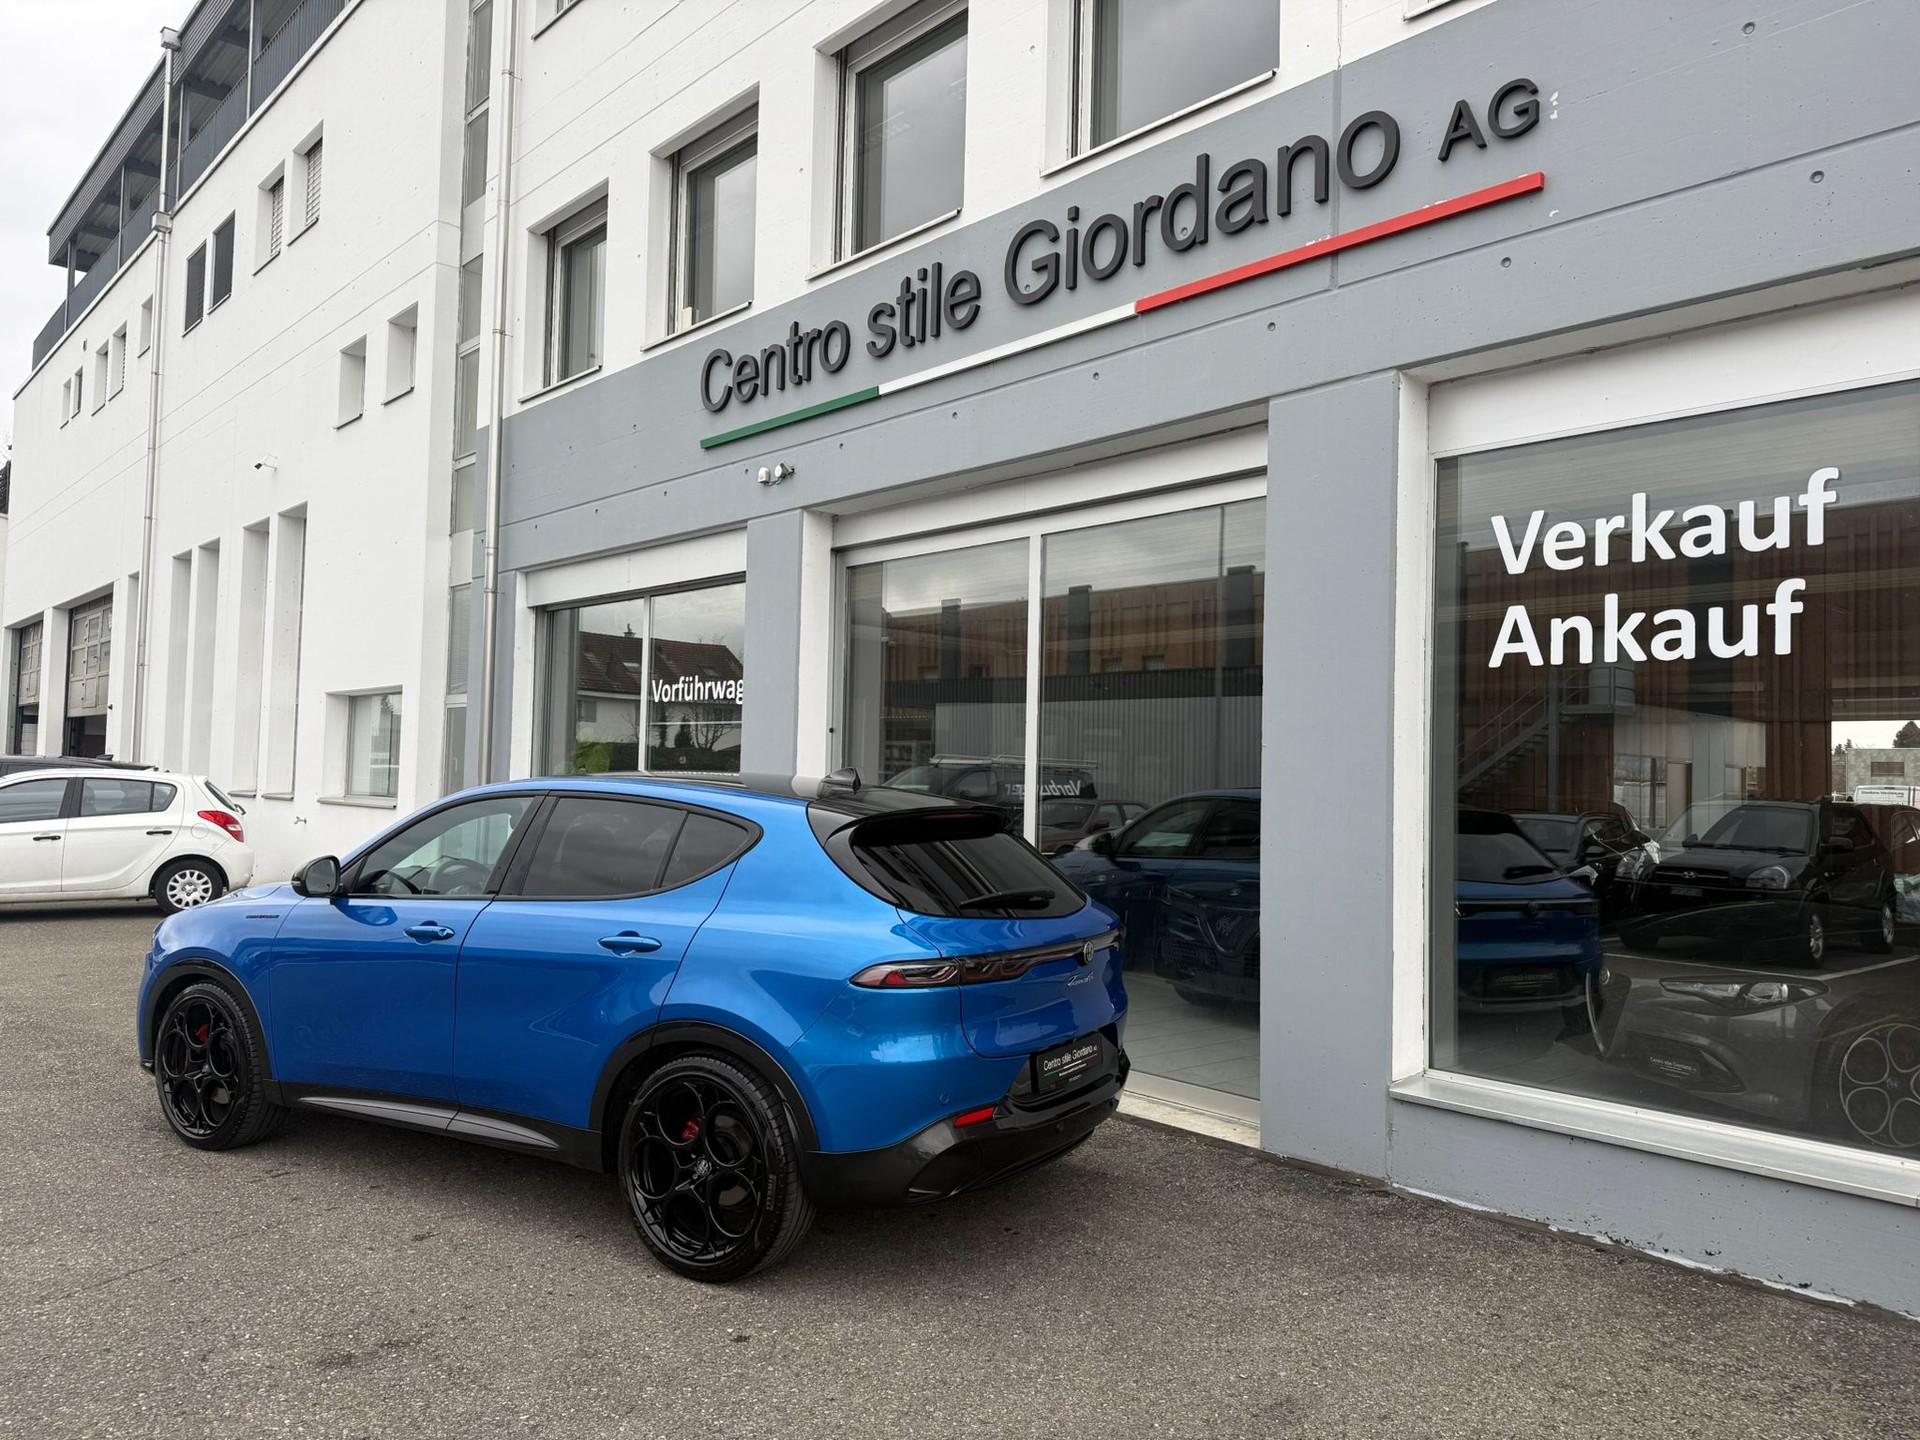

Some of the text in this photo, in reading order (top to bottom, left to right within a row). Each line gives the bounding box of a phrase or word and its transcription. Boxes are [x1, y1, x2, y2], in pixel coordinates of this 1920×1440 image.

[700, 78, 1540, 412] Centro stile Giordano AG
[1490, 467, 1840, 575] Verkauf
[1488, 578, 1806, 669] Ankauf
[652, 675, 743, 704] Vorführwag
[1043, 1058, 1061, 1071] Centro
[1072, 1045, 1093, 1060] Giordano
